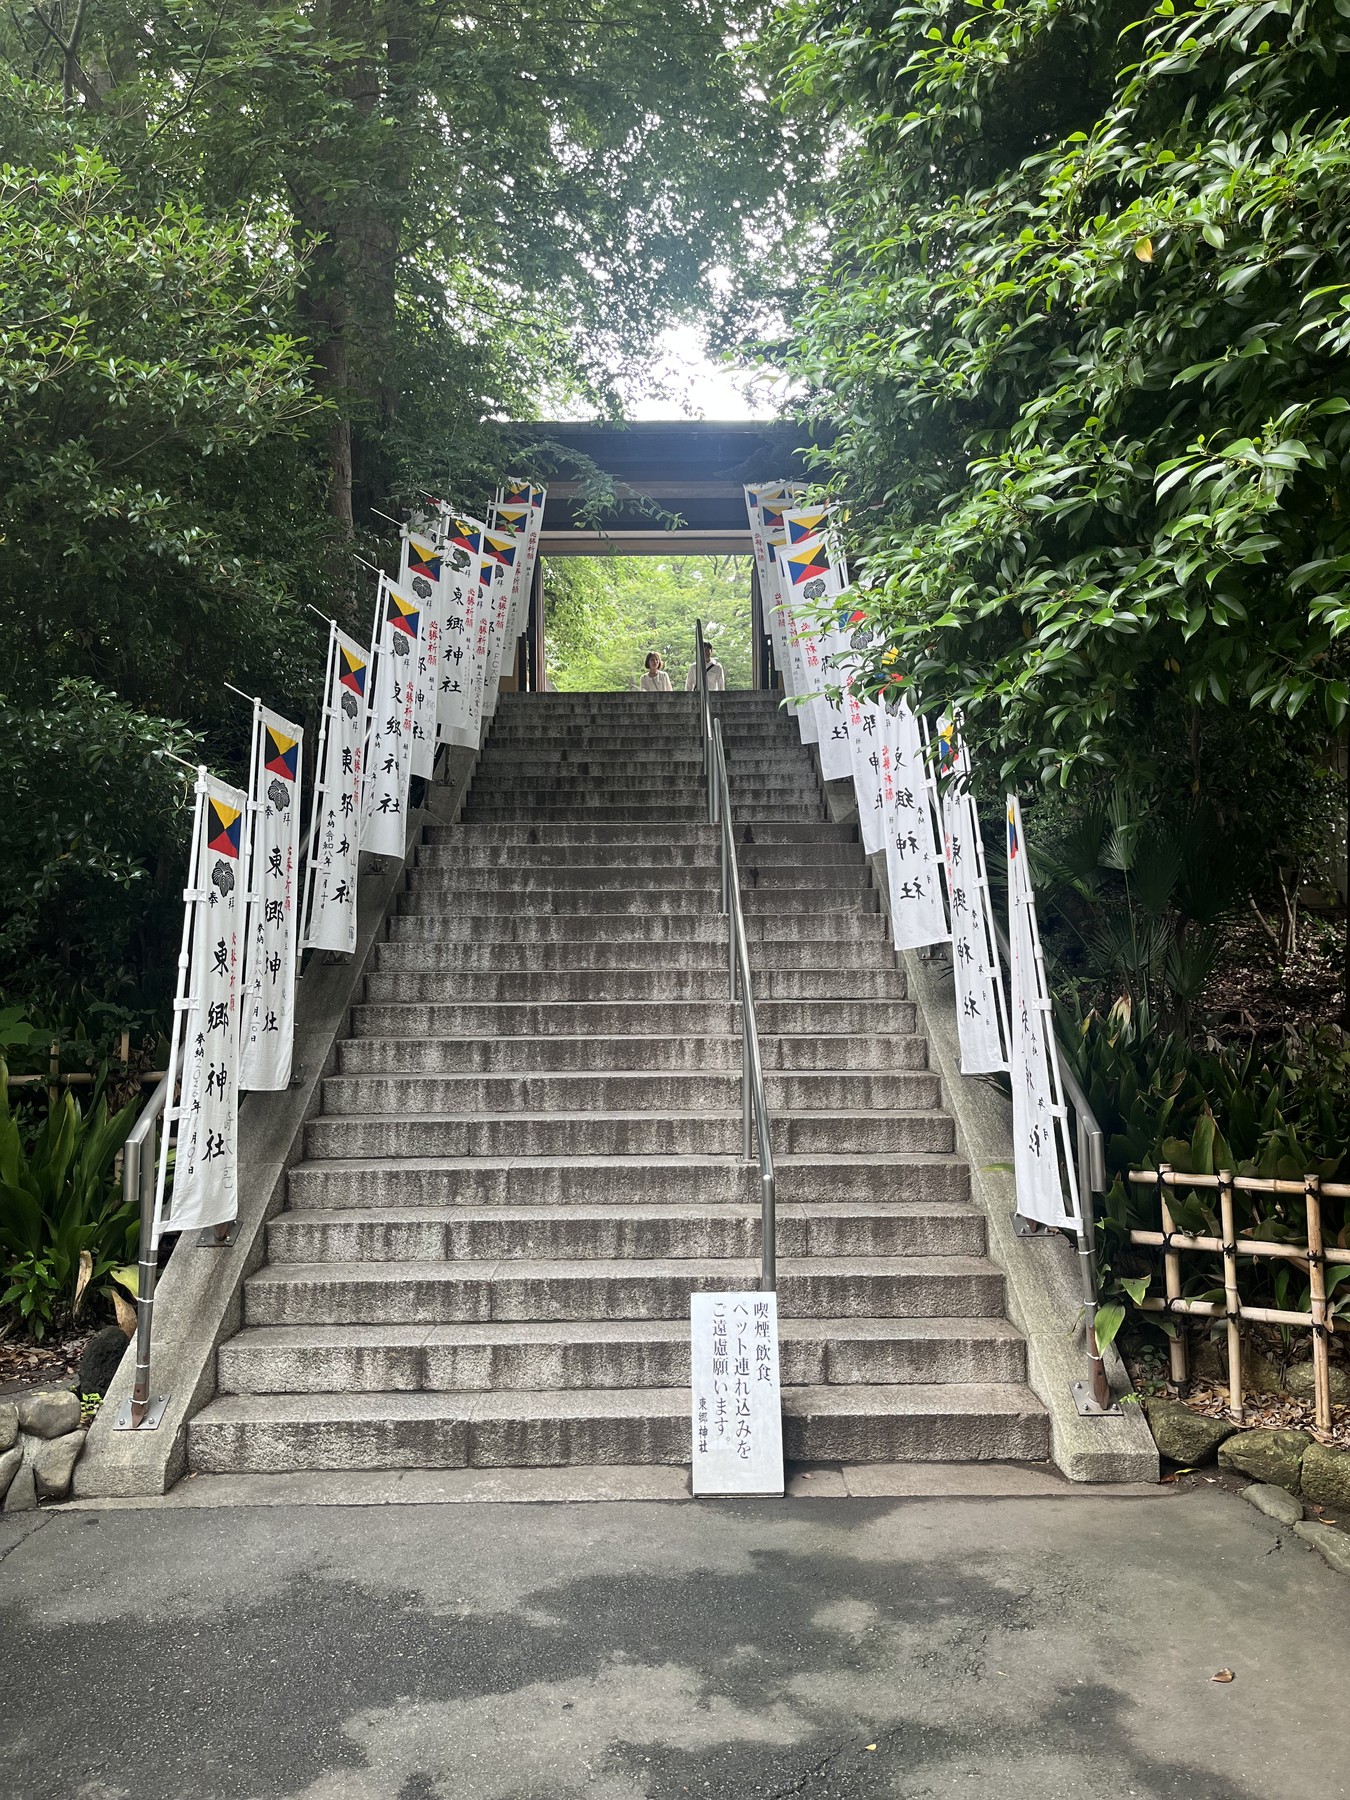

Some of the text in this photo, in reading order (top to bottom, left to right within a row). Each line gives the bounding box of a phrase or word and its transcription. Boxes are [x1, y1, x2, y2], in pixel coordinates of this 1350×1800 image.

[465, 588, 475, 628] 必勝祈願
[476, 618, 487, 655] 必勝祈願
[496, 595, 506, 629] 必勝祈願
[427, 620, 438, 666] 必勝祈願
[438, 587, 464, 693] 東郷神社
[402, 682, 413, 732] 必勝祈願
[353, 747, 361, 805] 必勝祈願
[262, 845, 285, 1034] 東郷神社
[201, 936, 230, 1163] 東郷神社
[712, 1302, 731, 1443] ご遠慮願います。
[753, 1301, 773, 1388] 喫煙、飲食、
[732, 1301, 752, 1460] ペット連れ込みを
[698, 1396, 709, 1454] 東郷神社
